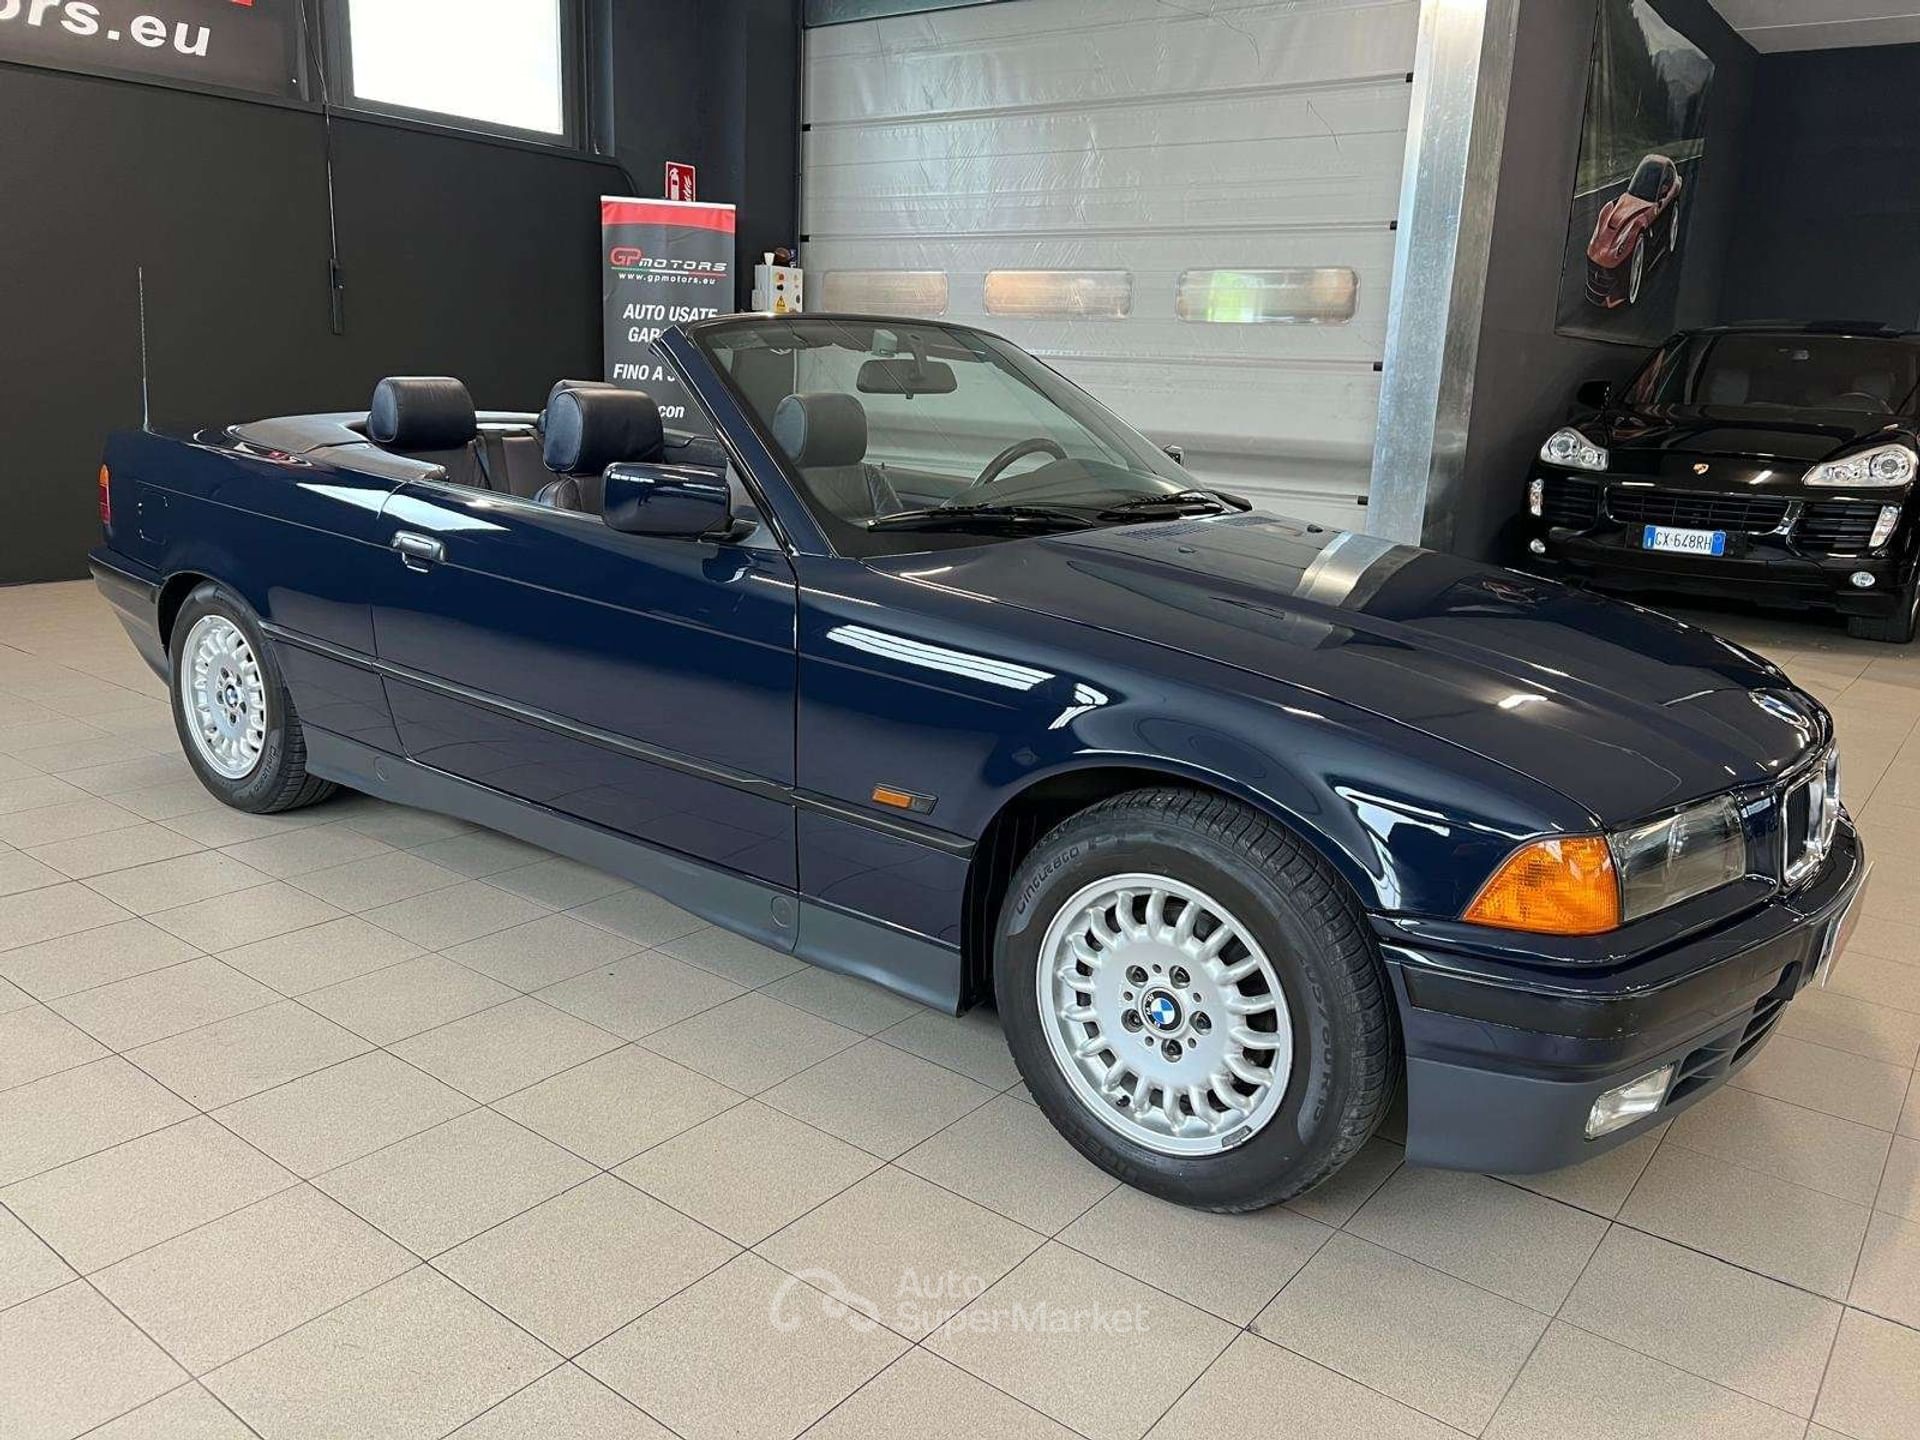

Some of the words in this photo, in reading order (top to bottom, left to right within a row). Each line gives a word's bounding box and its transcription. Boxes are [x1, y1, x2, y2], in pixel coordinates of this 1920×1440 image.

[0, 0, 210, 56] rs.eu
[618, 272, 716, 285] www.gpmotors.eu
[622, 303, 665, 321] AUTO
[628, 326, 667, 343] GAR
[613, 363, 649, 380] FINO
[651, 366, 663, 381] A
